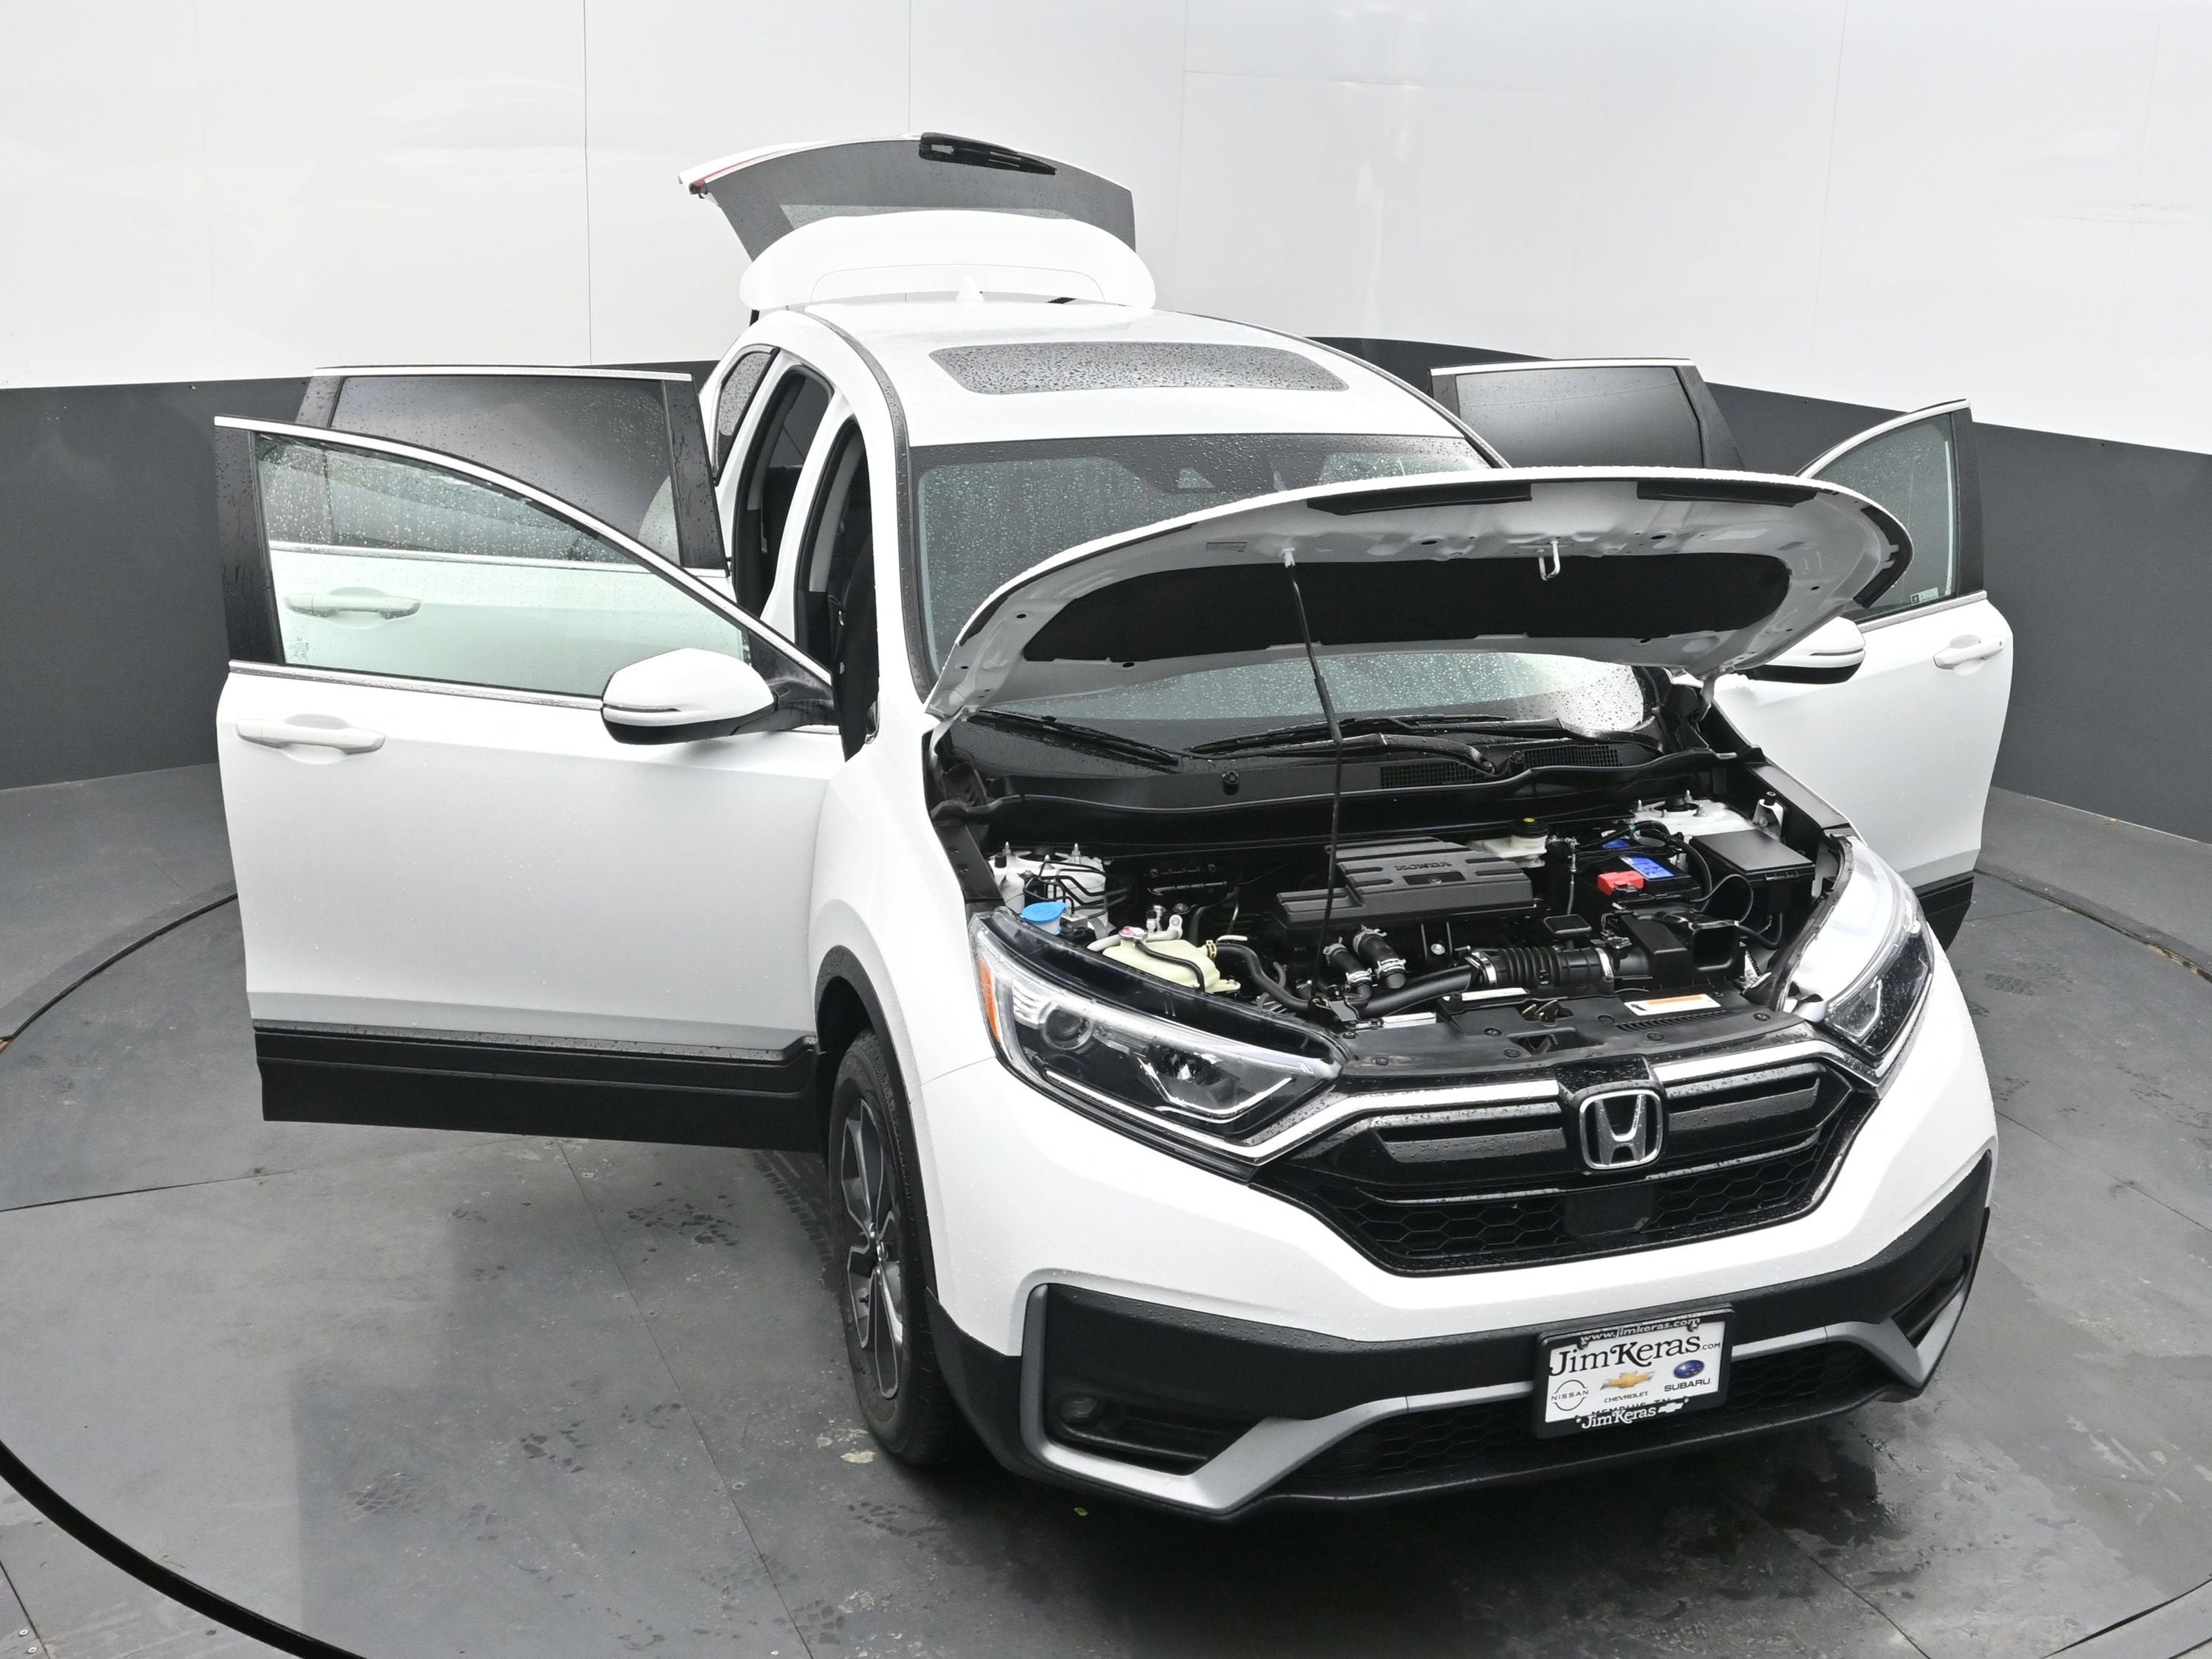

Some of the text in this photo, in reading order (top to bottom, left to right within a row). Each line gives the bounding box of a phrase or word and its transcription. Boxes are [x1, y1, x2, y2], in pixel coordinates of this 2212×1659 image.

[1664, 1377, 1711, 1392] SUBARU
[1551, 1389, 1589, 1401] NISSAN
[1604, 1391, 1649, 1403] CHEVROLET
